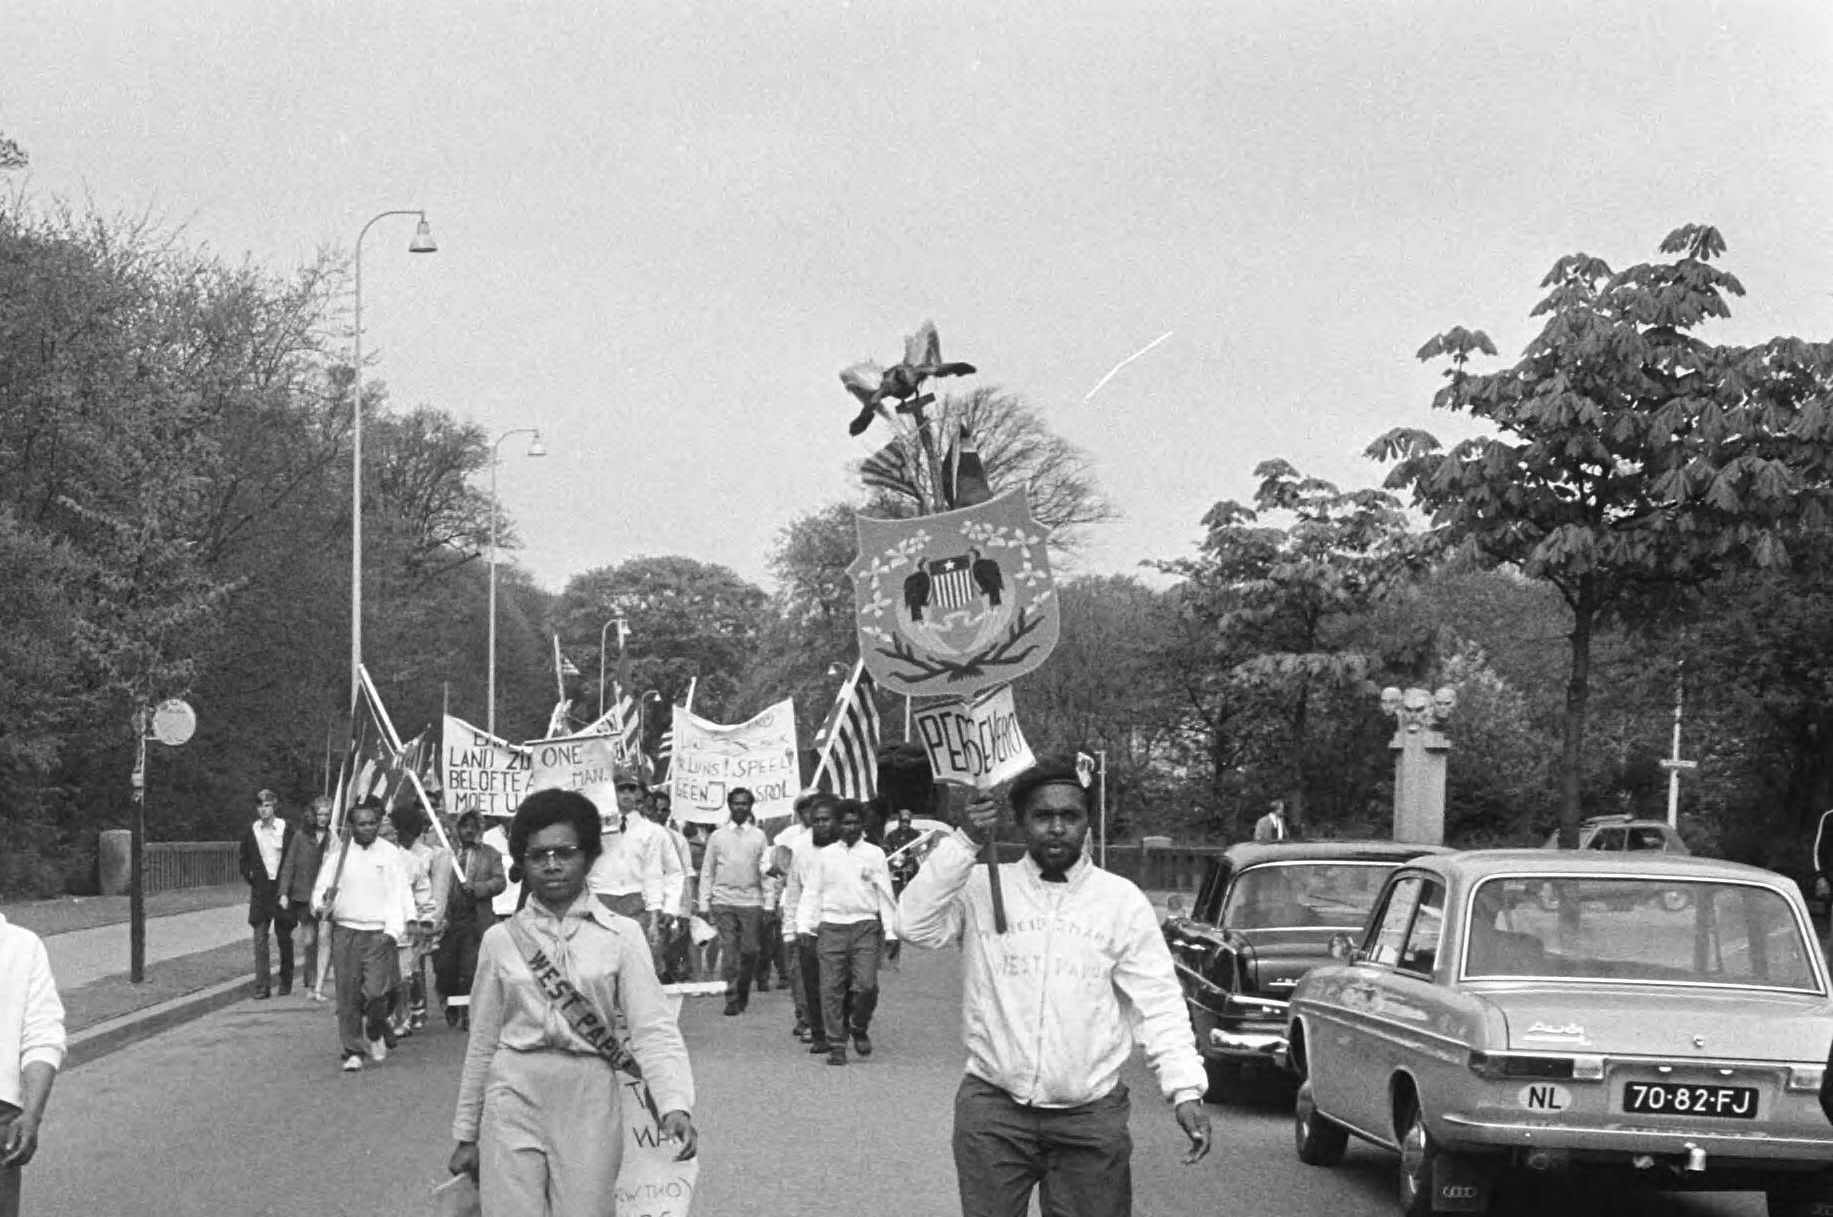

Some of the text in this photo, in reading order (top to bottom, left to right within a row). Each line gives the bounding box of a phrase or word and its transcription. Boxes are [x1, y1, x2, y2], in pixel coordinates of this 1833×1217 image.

[449, 747, 494, 768] LAND
[541, 746, 583, 768] ONE
[449, 770, 520, 792] BELOFTE
[455, 793, 500, 813] MOET
[528, 949, 583, 1010] WEST
[1528, 1086, 1562, 1110] NL
[1632, 1085, 1751, 1114] 70-82-FJ
